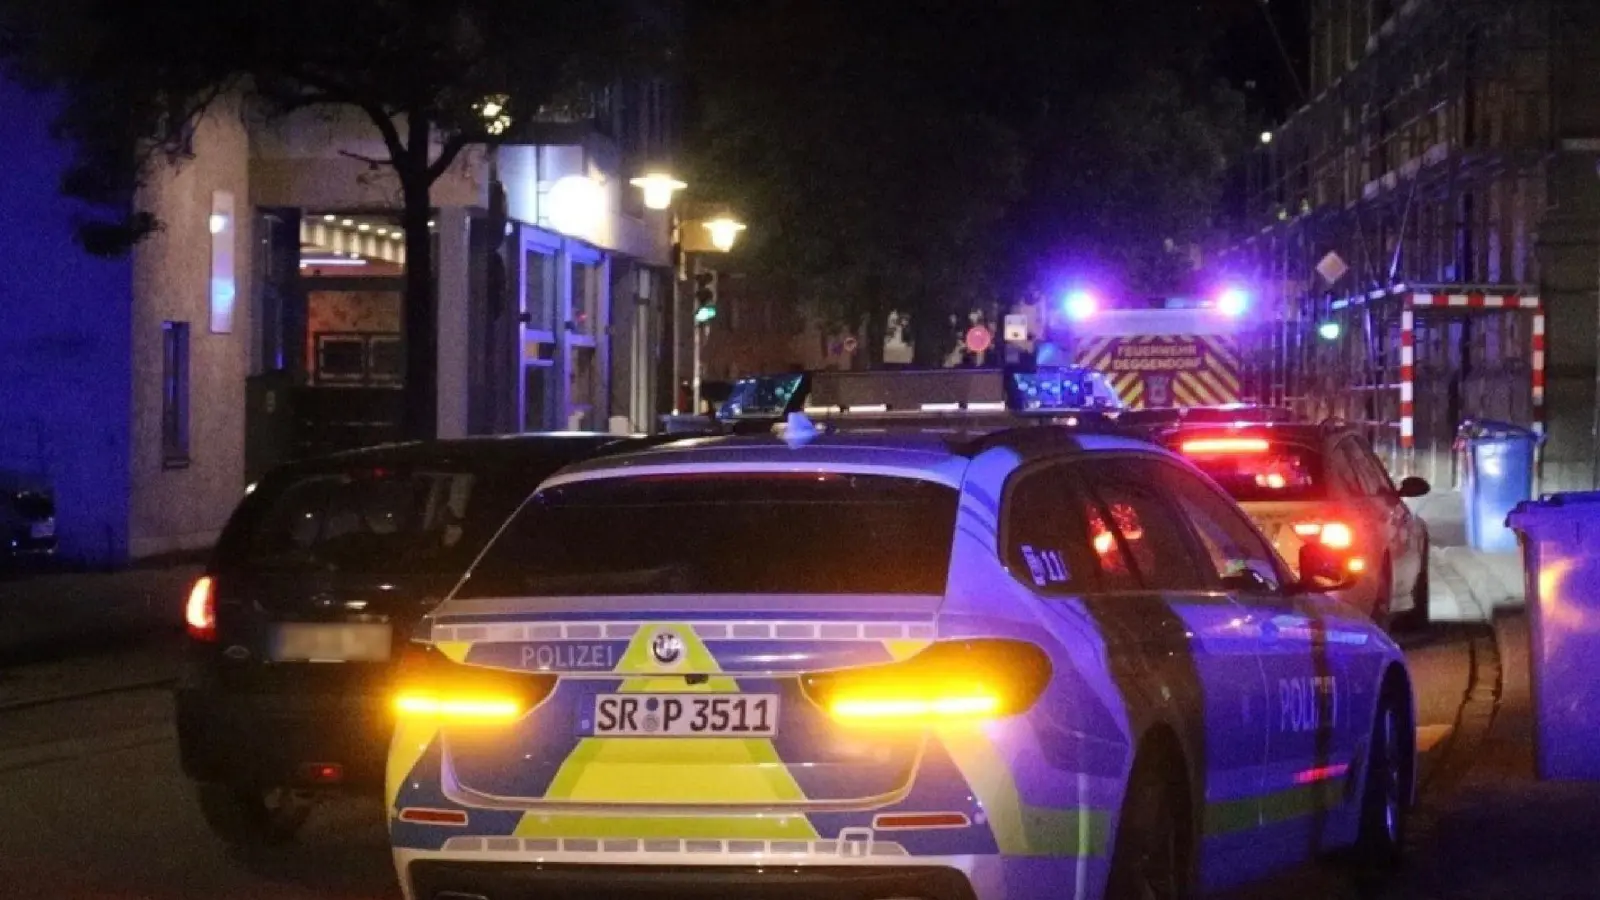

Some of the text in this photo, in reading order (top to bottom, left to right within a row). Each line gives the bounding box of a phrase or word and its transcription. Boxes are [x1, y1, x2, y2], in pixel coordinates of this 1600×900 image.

[1118, 344, 1197, 357] FEUERWEHR
[1112, 357, 1202, 370] DEGGENDORF
[520, 644, 613, 669] POLIZEI
[597, 697, 771, 732] SR P 3511
